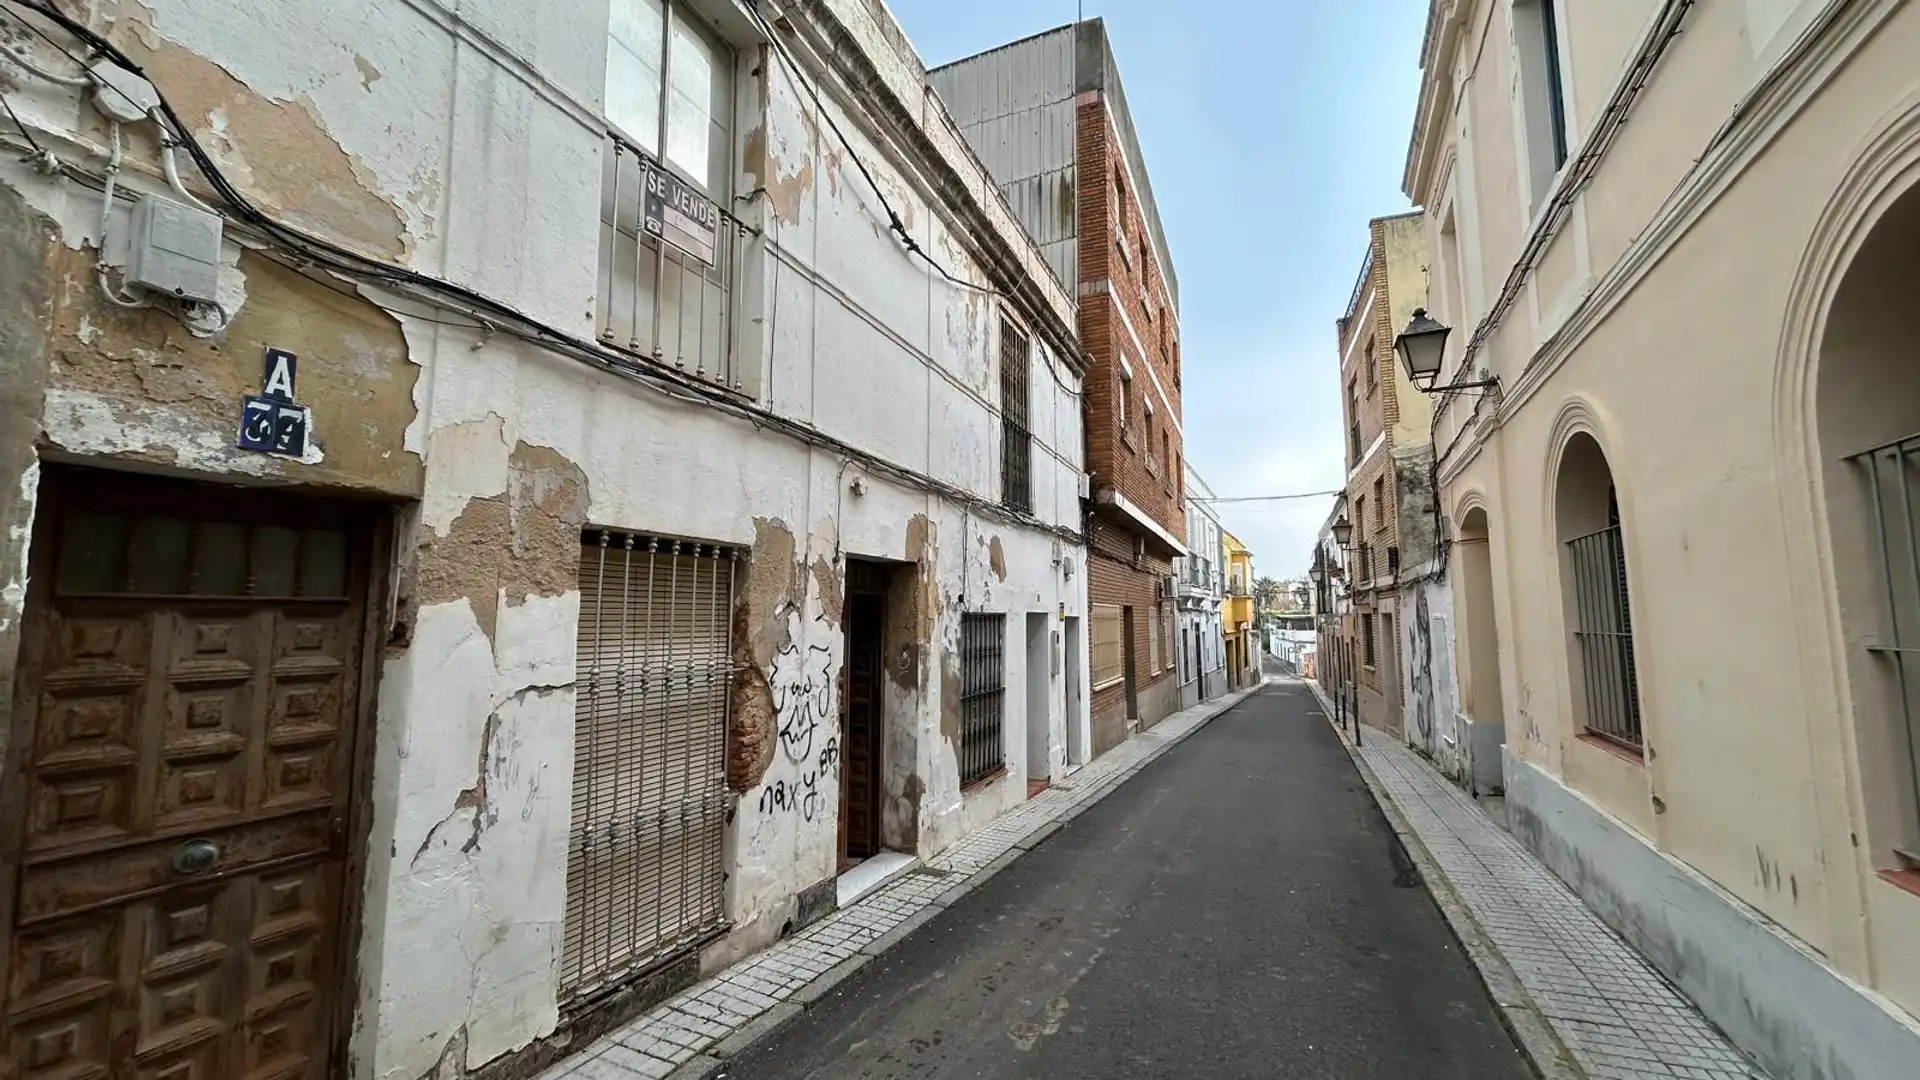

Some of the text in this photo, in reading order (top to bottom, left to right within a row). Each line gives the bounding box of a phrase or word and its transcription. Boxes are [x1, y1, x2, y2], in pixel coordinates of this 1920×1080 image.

[647, 171, 666, 198] SE
[673, 185, 715, 227] VENDE
[265, 356, 293, 399] A
